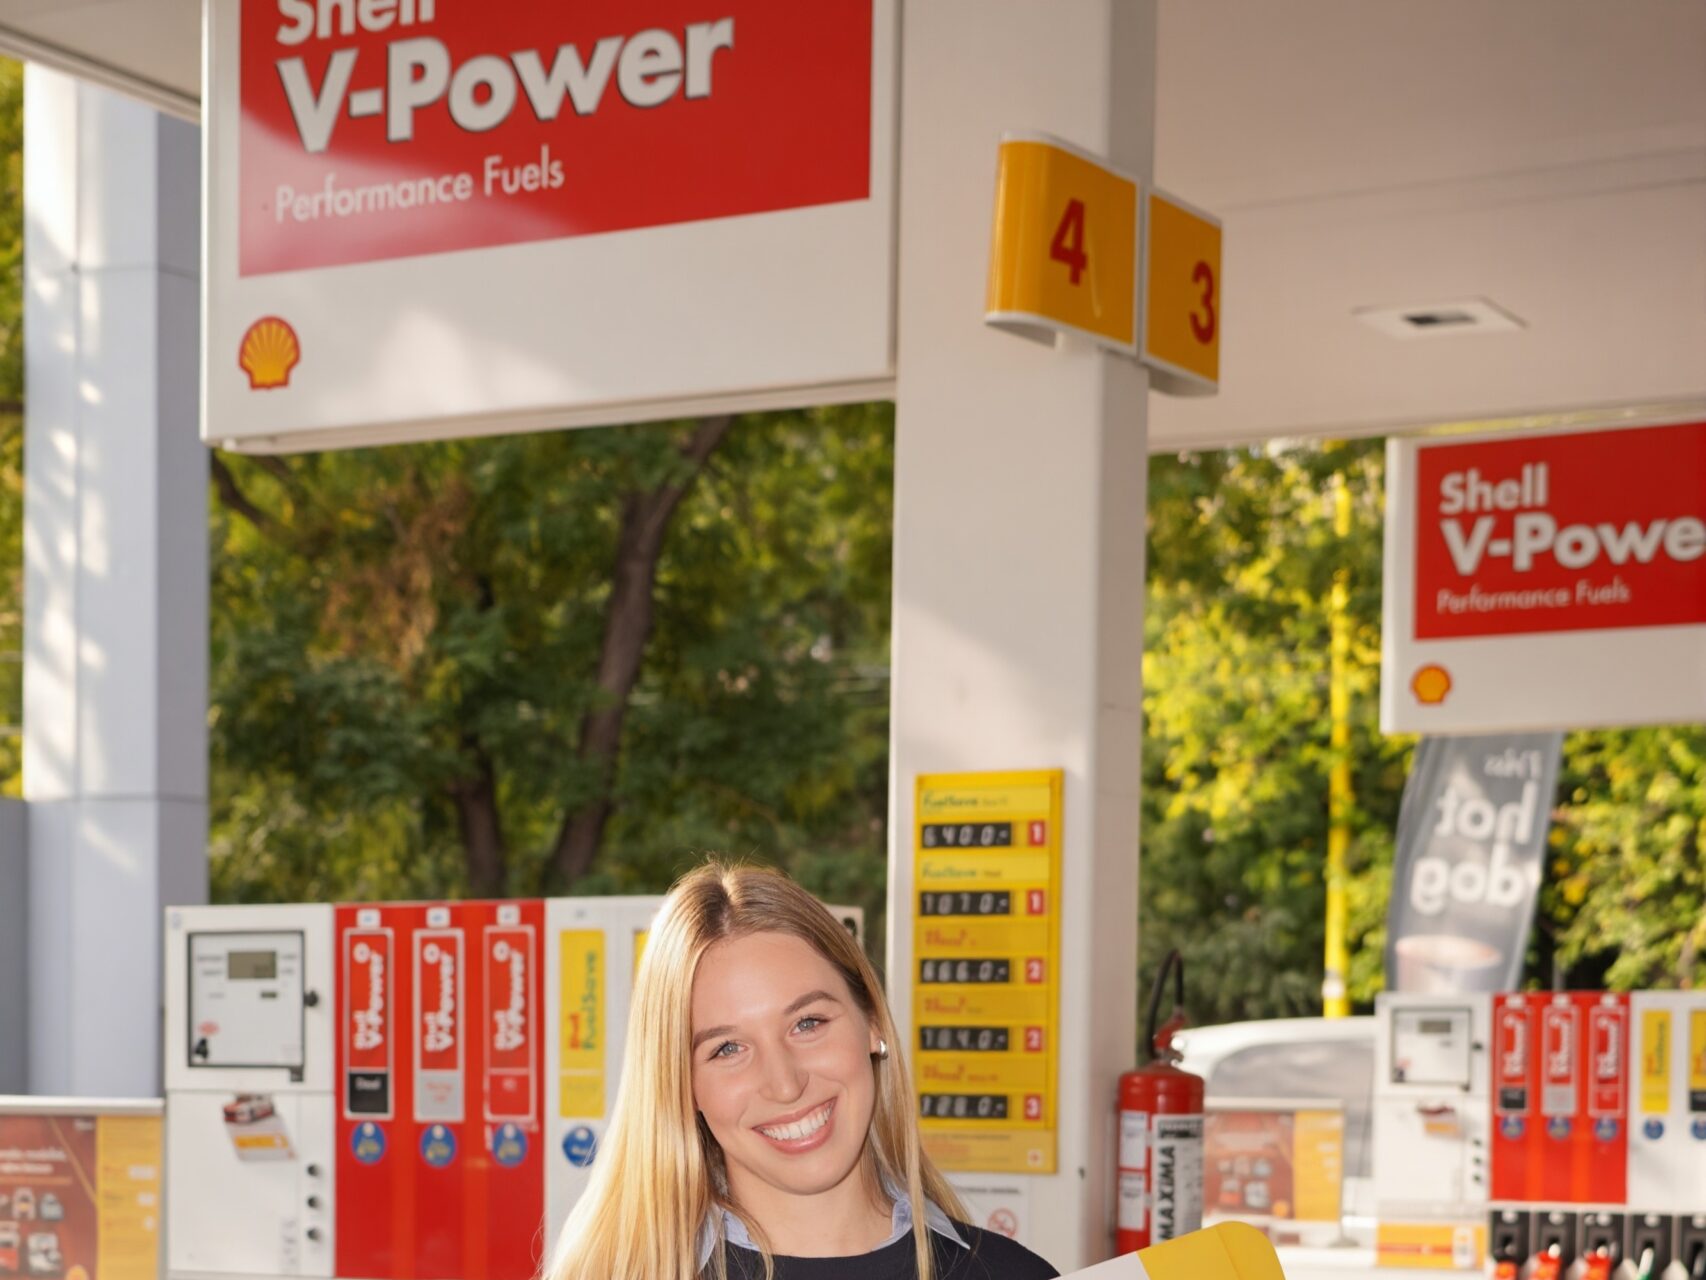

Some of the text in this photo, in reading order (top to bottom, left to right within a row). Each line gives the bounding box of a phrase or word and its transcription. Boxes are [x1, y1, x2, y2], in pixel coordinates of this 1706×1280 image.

[275, 16, 735, 154] V-Power
[275, 144, 565, 224] Performance Fuels
[1050, 197, 1087, 287] 4
[1190, 259, 1215, 345] 3
[1439, 462, 1548, 515] Shell
[1436, 575, 1632, 615] Performance Fuels
